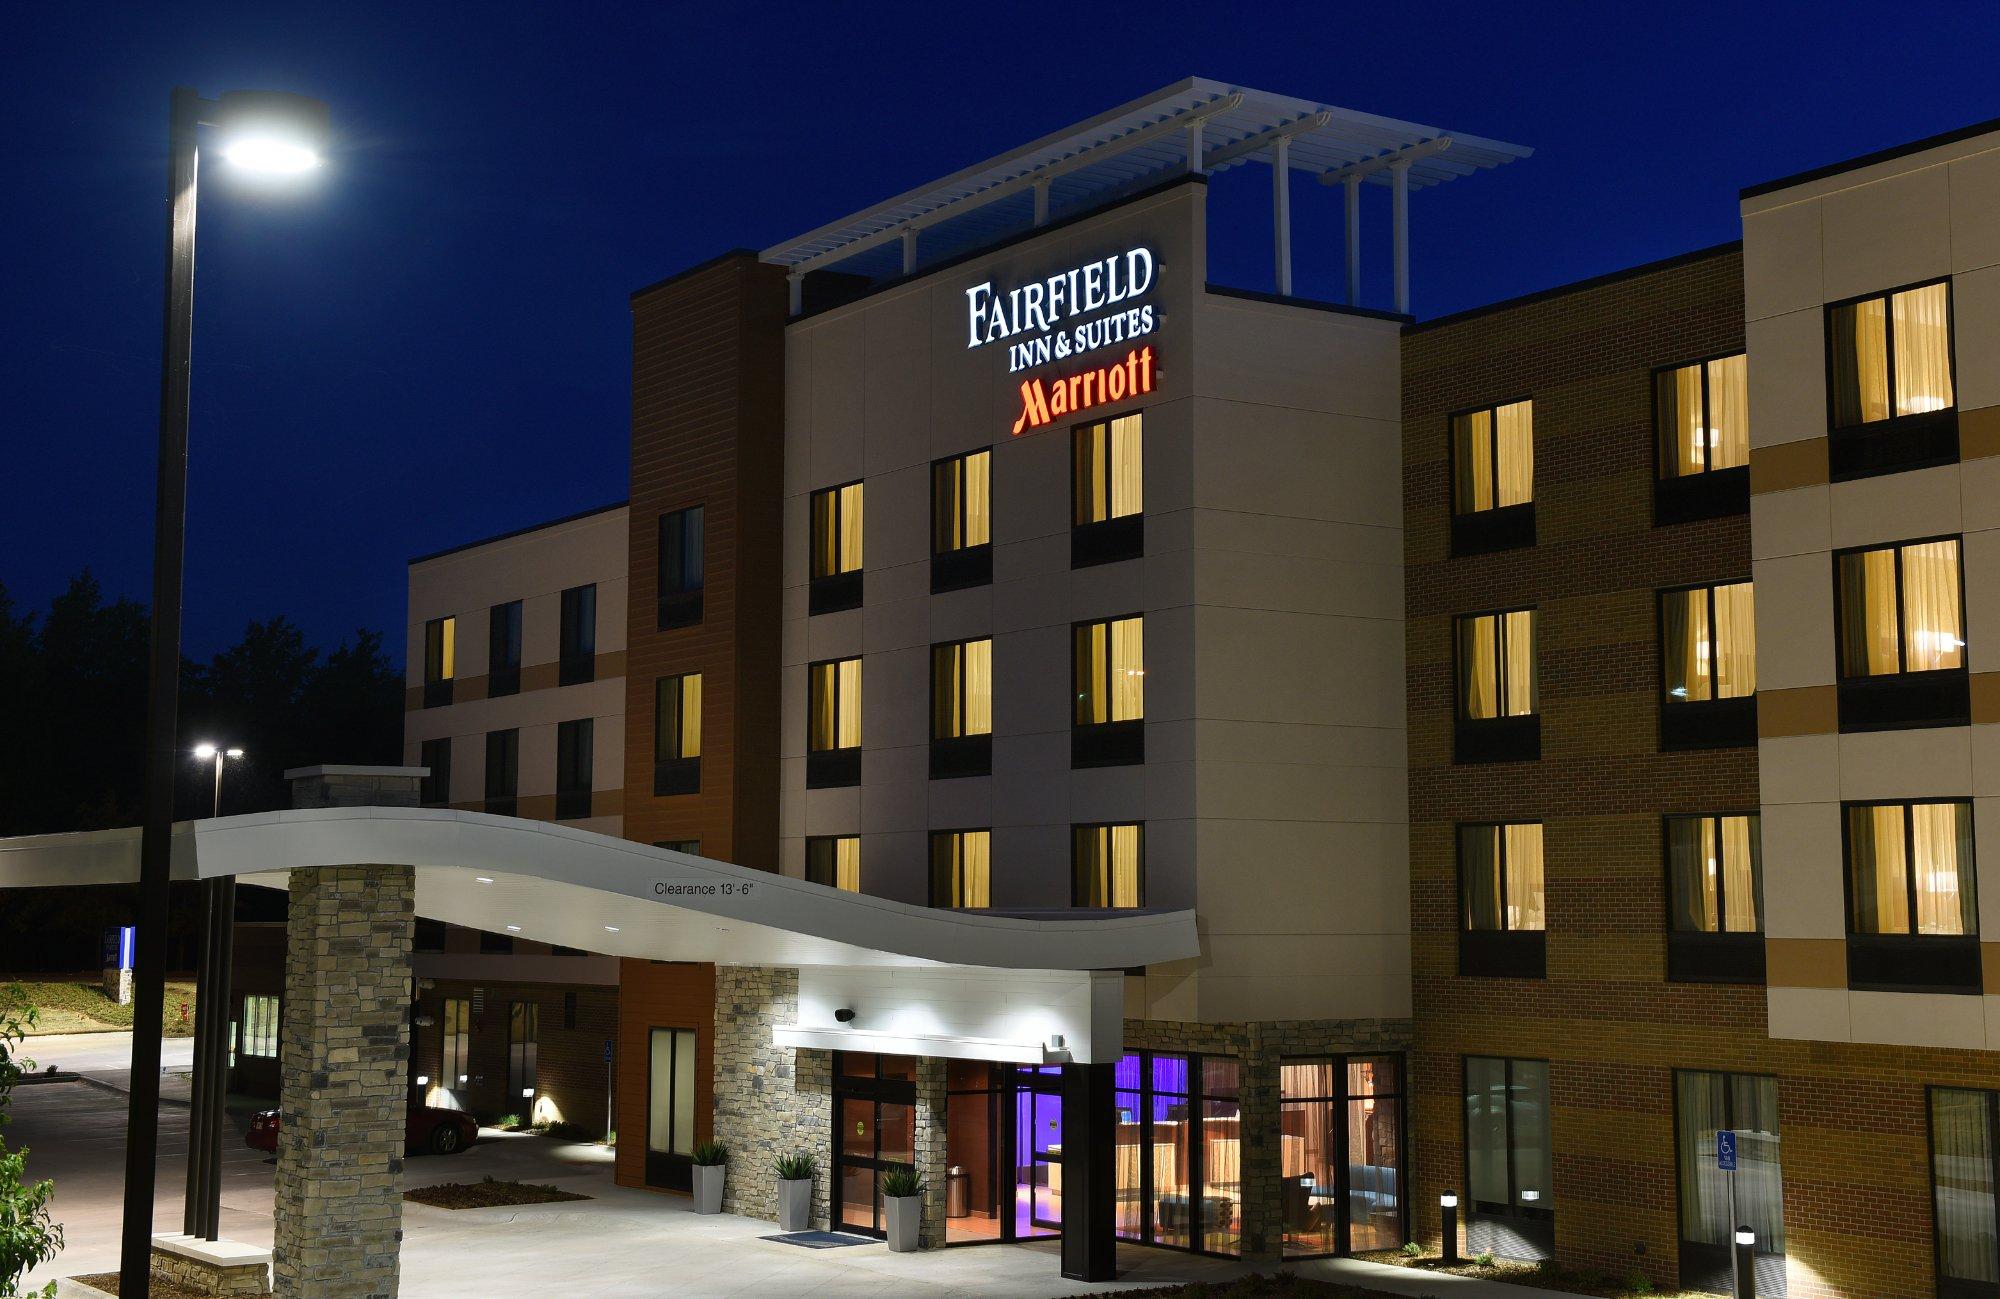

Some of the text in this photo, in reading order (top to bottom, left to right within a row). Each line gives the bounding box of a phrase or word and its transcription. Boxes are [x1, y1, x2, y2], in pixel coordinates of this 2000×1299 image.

[965, 247, 1154, 349] FAIRFIELD
[1012, 346, 1153, 436] Marriott
[654, 882, 716, 895] Clearance
